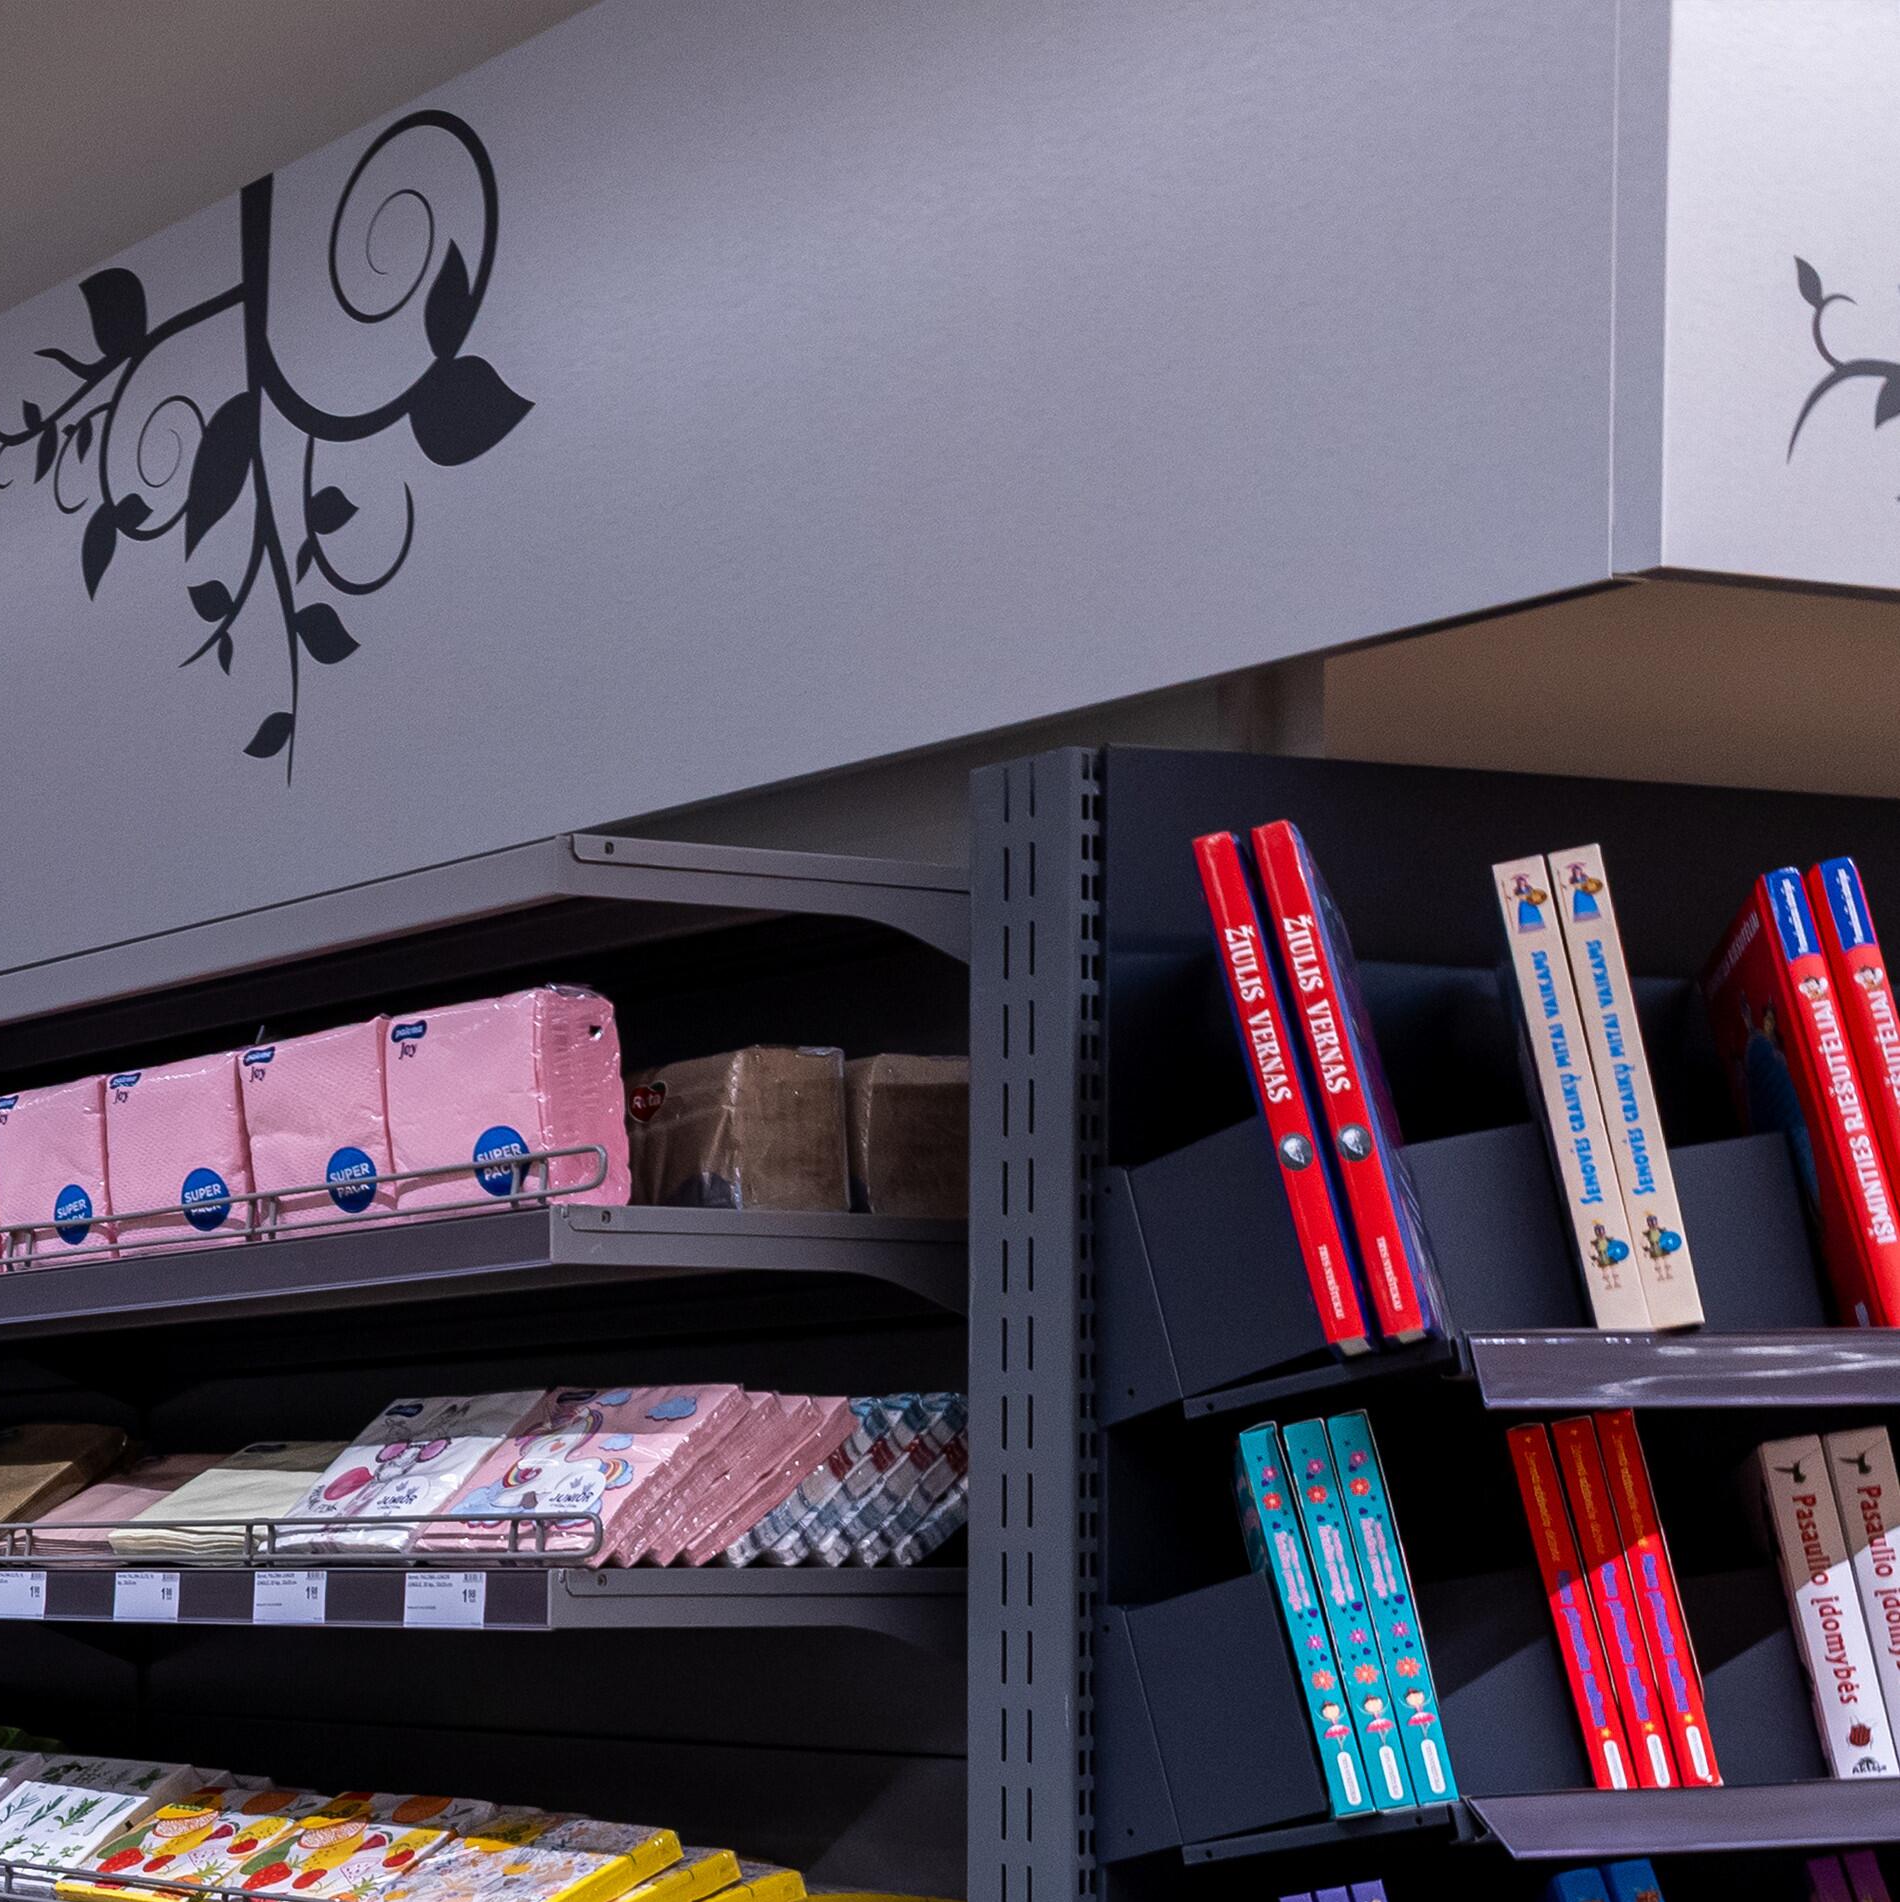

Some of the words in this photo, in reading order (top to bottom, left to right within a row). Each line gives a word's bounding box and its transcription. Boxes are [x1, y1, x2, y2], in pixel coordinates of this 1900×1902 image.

[1283, 914, 1324, 992] ŽIULIS
[1307, 999, 1351, 1094] VERNAS
[1531, 950, 1560, 1019] VAIKAMS
[1586, 939, 1613, 1008] VAIKAMS
[1225, 925, 1267, 1003] ŽIULIS
[1248, 1009, 1293, 1104] VERNAS
[1549, 1023, 1572, 1068] MITAI
[1602, 1013, 1625, 1058] MITAI
[1812, 1000, 1867, 1132] RIEŠUTĖLIAI
[329, 1162, 370, 1184] SUPER
[476, 1143, 522, 1164] SUPER
[1569, 1137, 1604, 1205] SENOVĖS
[1622, 1127, 1656, 1195] SENOVĖS
[57, 1199, 87, 1219] SUPER
[184, 1183, 222, 1203] SUPER
[1849, 1134, 1898, 1245] IŠMINTIES
[1792, 1494, 1832, 1586] Pasaulio
[1857, 1485, 1898, 1578] Pasaulio
[1810, 1595, 1861, 1705] įdomybės
